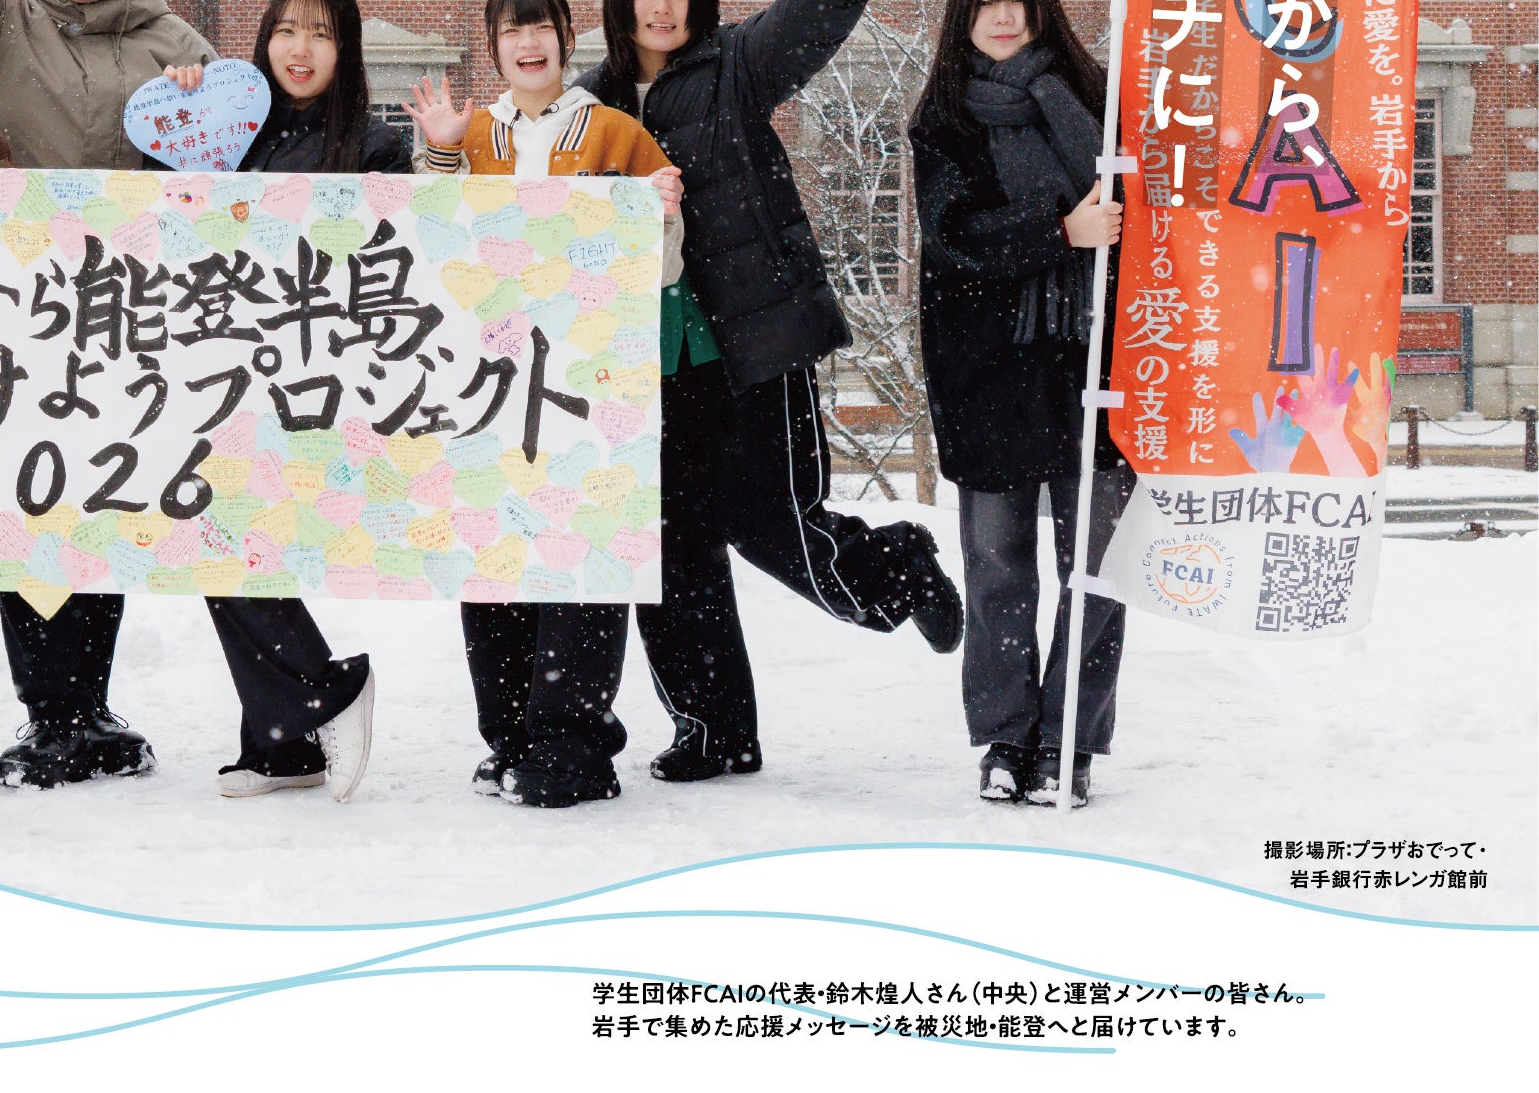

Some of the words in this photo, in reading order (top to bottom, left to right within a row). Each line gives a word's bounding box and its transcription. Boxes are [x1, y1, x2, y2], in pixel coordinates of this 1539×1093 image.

[1161, 559, 1214, 585] FCAI
[1184, 532, 1227, 552] Actions
[1224, 556, 1235, 589] from
